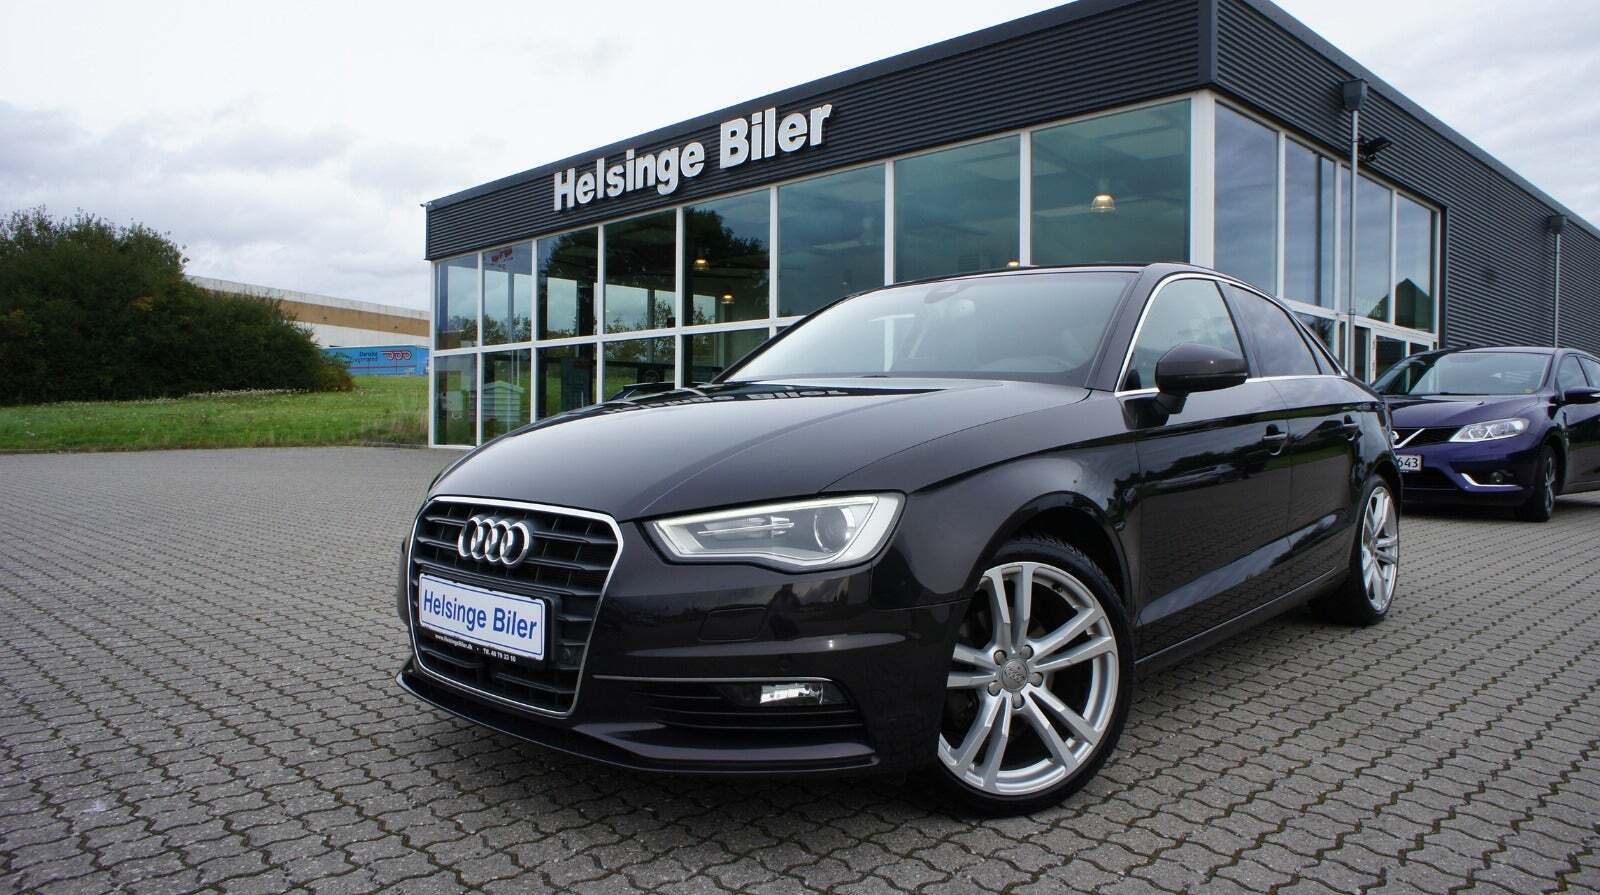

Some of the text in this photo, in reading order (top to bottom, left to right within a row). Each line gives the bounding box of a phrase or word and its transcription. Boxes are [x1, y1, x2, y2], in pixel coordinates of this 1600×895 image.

[553, 103, 833, 212] Helsinge Biler
[423, 589, 538, 640] Helsinge Biler
